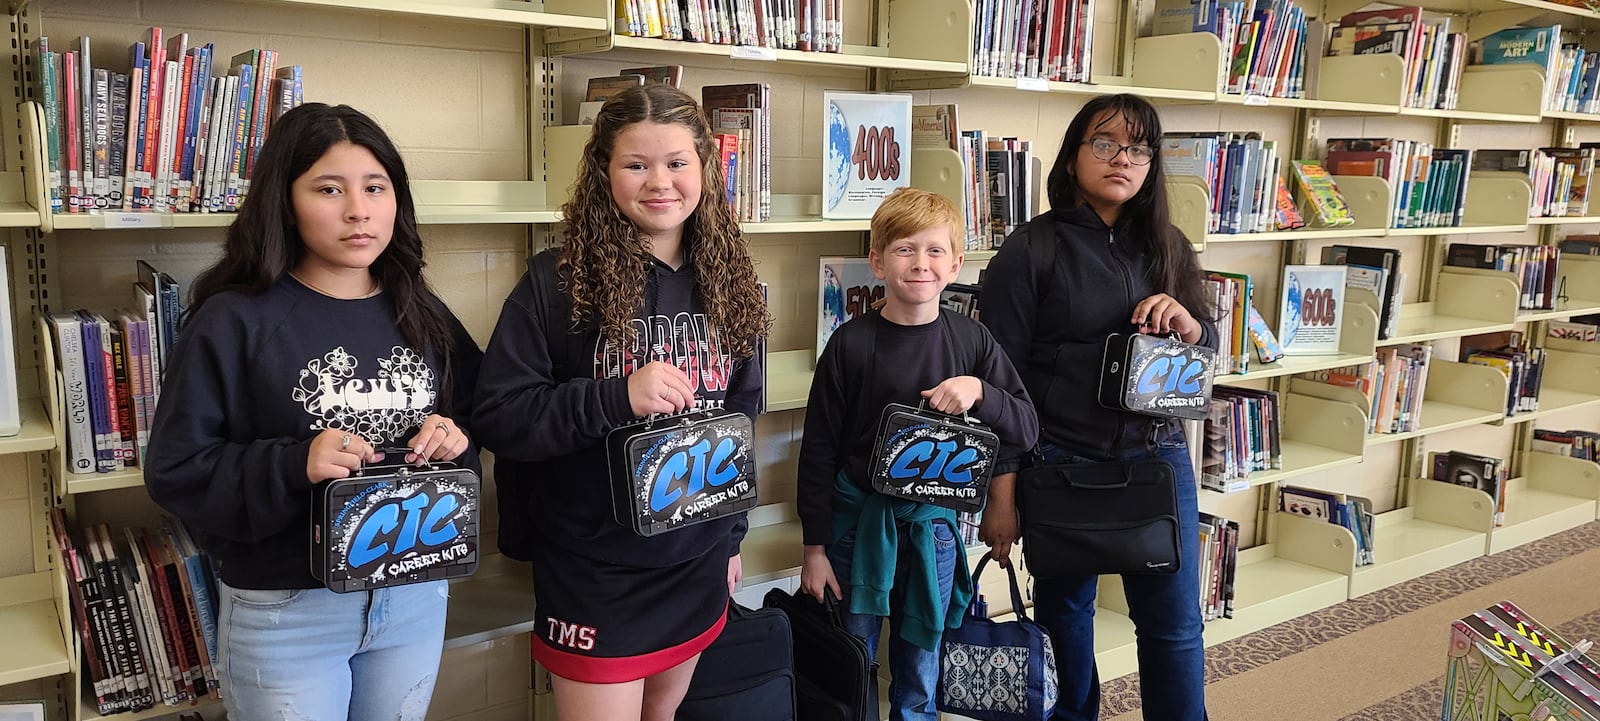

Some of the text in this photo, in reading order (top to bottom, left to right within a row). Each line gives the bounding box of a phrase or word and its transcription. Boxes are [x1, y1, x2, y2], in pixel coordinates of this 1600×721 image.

[1499, 41, 1534, 49] MODERN
[1504, 48, 1529, 57] ART
[113, 87, 126, 109] WAR
[283, 89, 292, 109] NAVY
[97, 81, 107, 145] NAVY SEAL DOGS
[112, 115, 125, 143] DOGS
[236, 122, 244, 142] FORCE
[63, 328, 71, 353] CLINTON
[132, 356, 142, 396] DRINKING
[142, 354, 152, 393] DRINKING
[1137, 355, 1204, 395] CTC
[70, 381, 85, 424] WORLD
[117, 382, 131, 438] FREE LUNCH
[1158, 398, 1188, 407] CAREER
[890, 440, 978, 482] CTC
[650, 438, 740, 512] CTC
[915, 485, 955, 496] CAREER
[335, 481, 389, 527] SPRINGFIELD-CLARK
[685, 492, 727, 517] CAREER
[348, 492, 459, 568] CTC
[388, 552, 441, 577] CAREER
[105, 598, 114, 608] IN
[117, 595, 126, 604] IN
[108, 609, 118, 623] THE
[120, 606, 130, 620] THE
[195, 586, 219, 644] Air Force One
[112, 625, 123, 642] LINE
[123, 622, 135, 639] LINE
[547, 617, 597, 650] TMS
[117, 644, 126, 655] OF
[128, 641, 138, 652] OF
[120, 658, 132, 677] FIRE
[131, 654, 144, 674] FIRE
